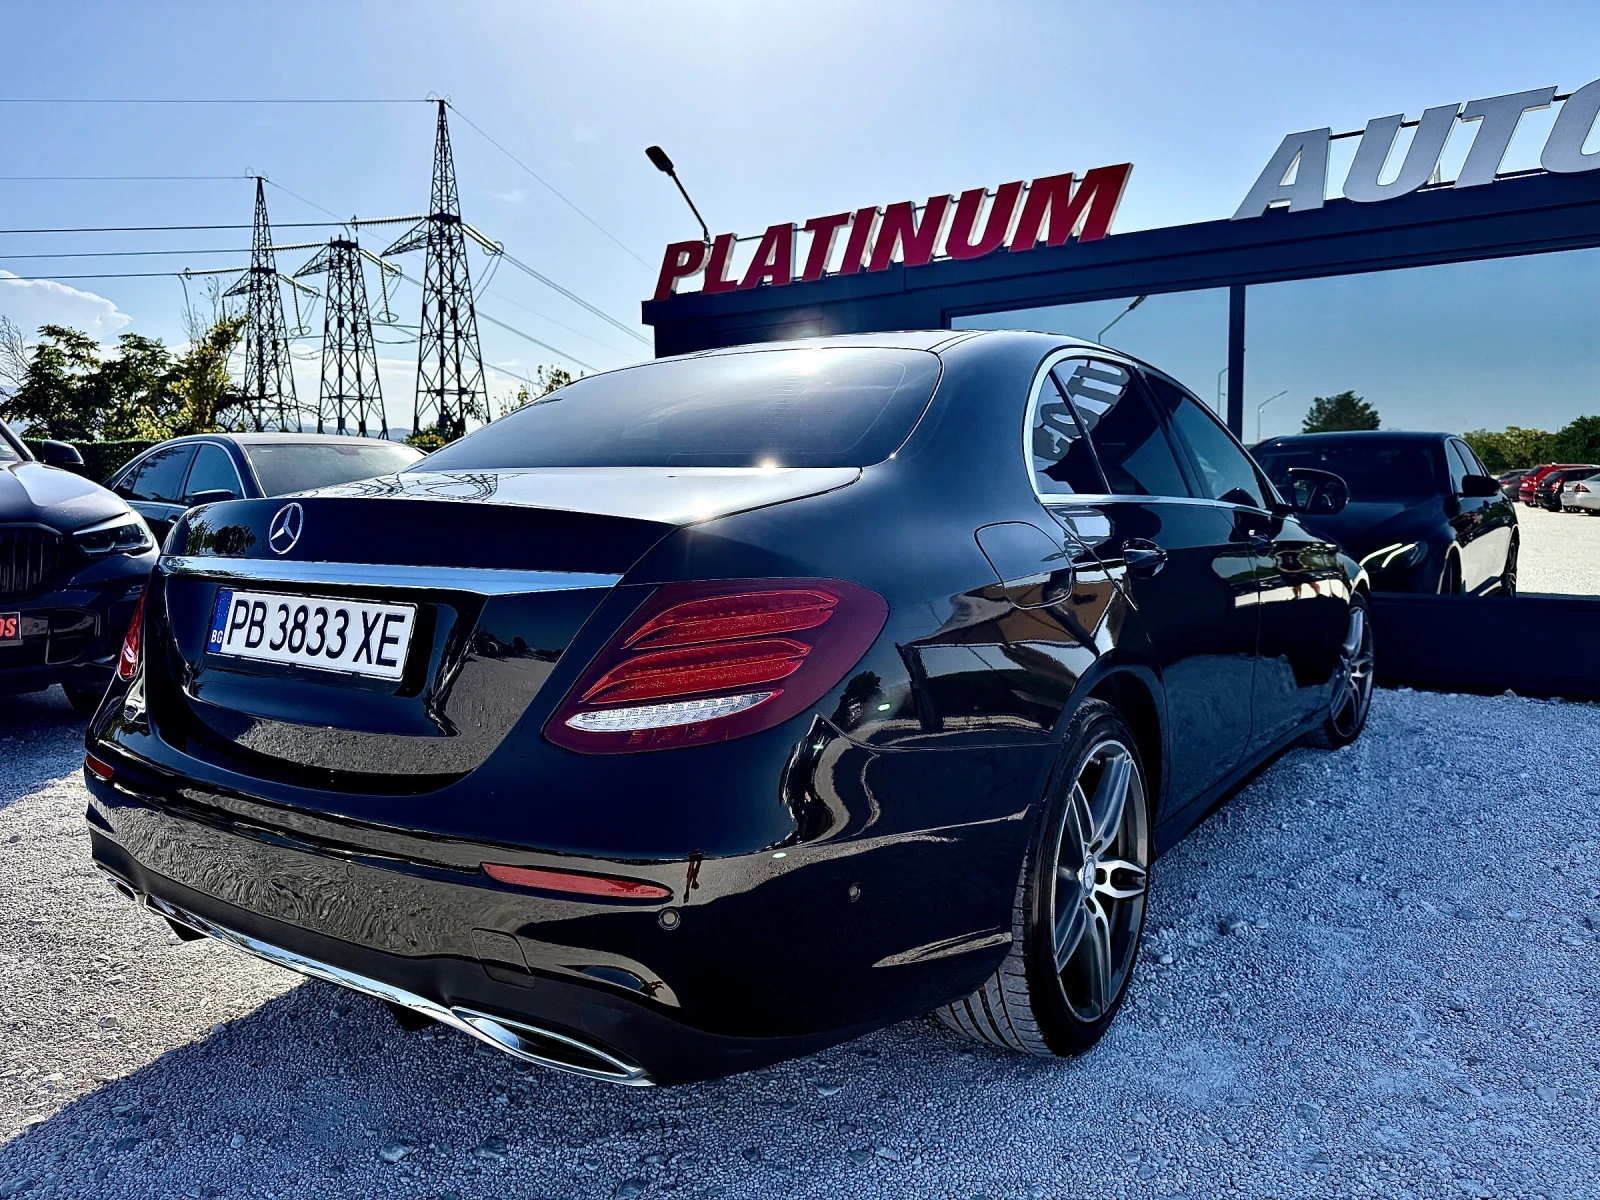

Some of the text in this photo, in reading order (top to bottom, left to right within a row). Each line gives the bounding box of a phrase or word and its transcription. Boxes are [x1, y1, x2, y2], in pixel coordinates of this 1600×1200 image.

[654, 162, 1133, 300] PLATINUM
[210, 629, 224, 645] BG
[226, 599, 407, 668] PB 3833 XE
